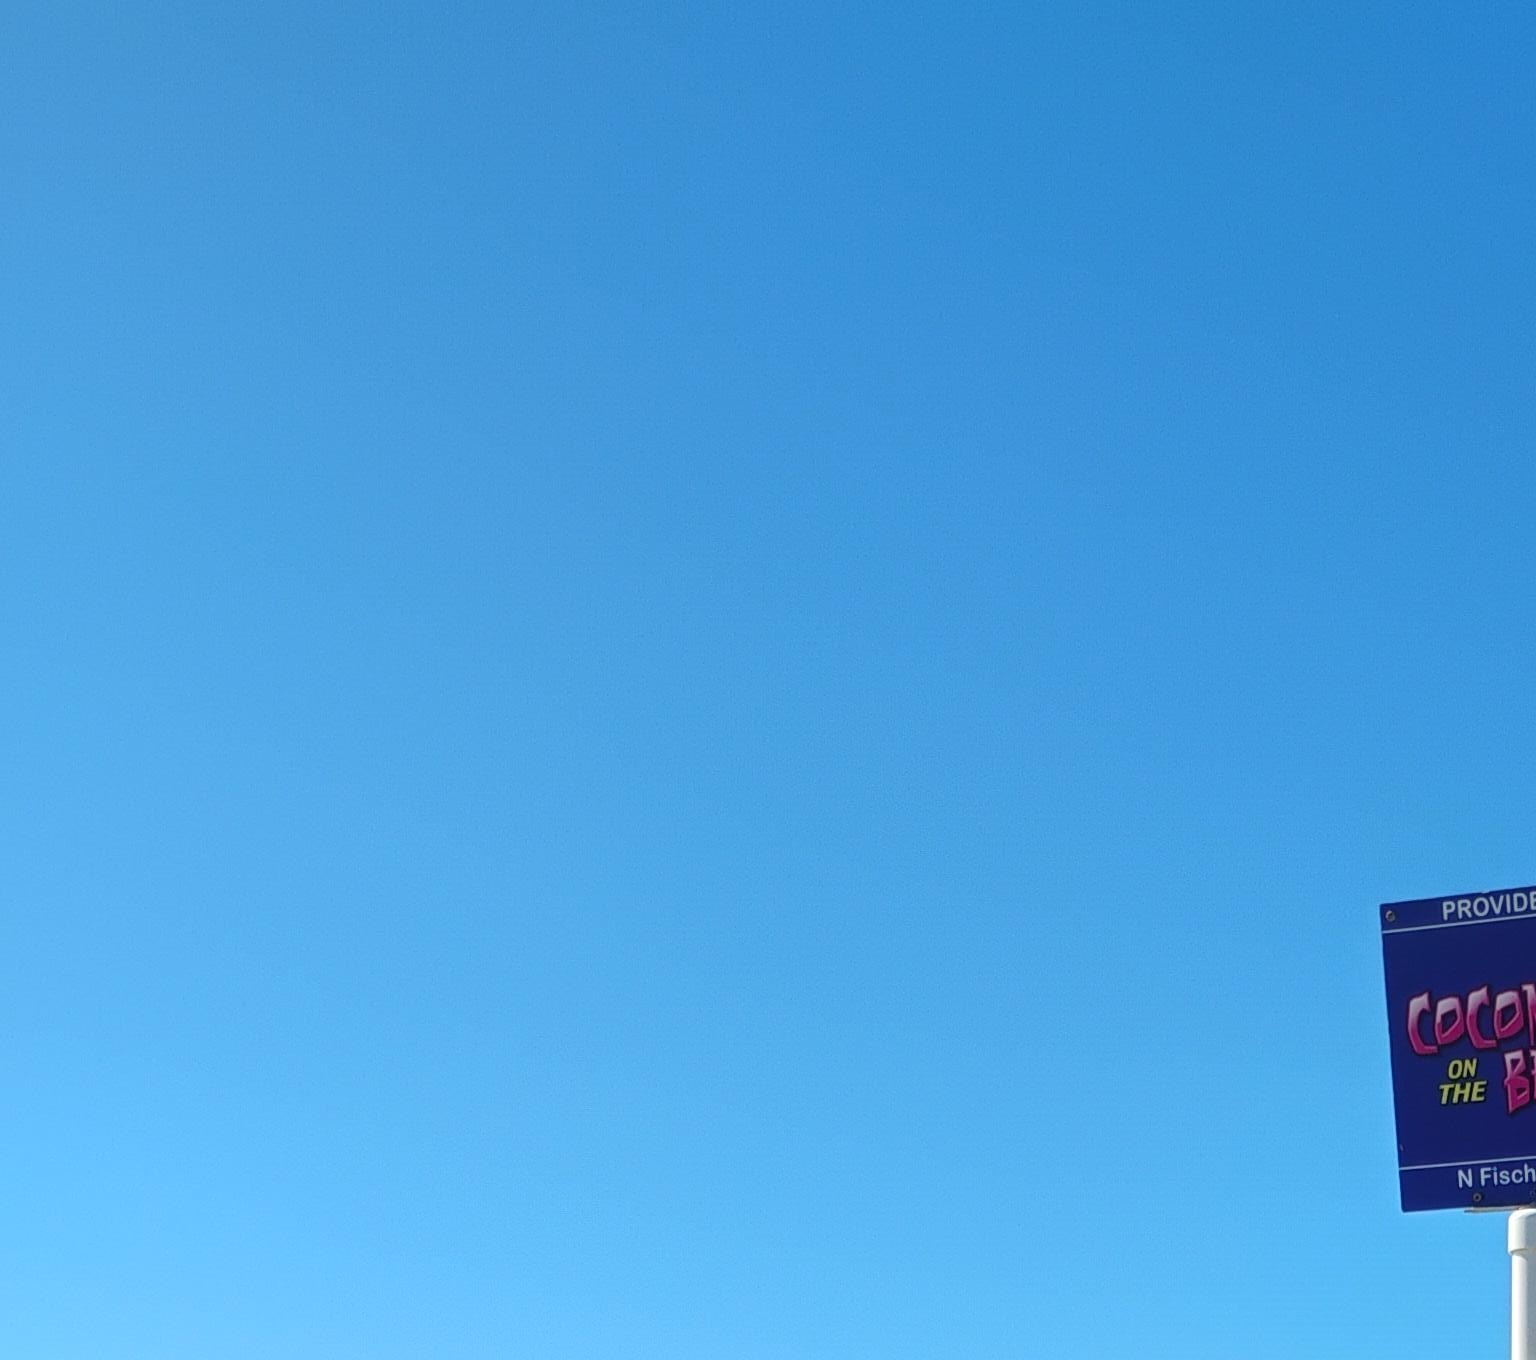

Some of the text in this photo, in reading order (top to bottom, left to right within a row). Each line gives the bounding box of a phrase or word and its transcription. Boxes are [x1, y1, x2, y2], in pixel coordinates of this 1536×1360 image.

[1448, 1058, 1477, 1080] ON
[1439, 1080, 1487, 1104] THE
[1457, 1169, 1474, 1188] N
